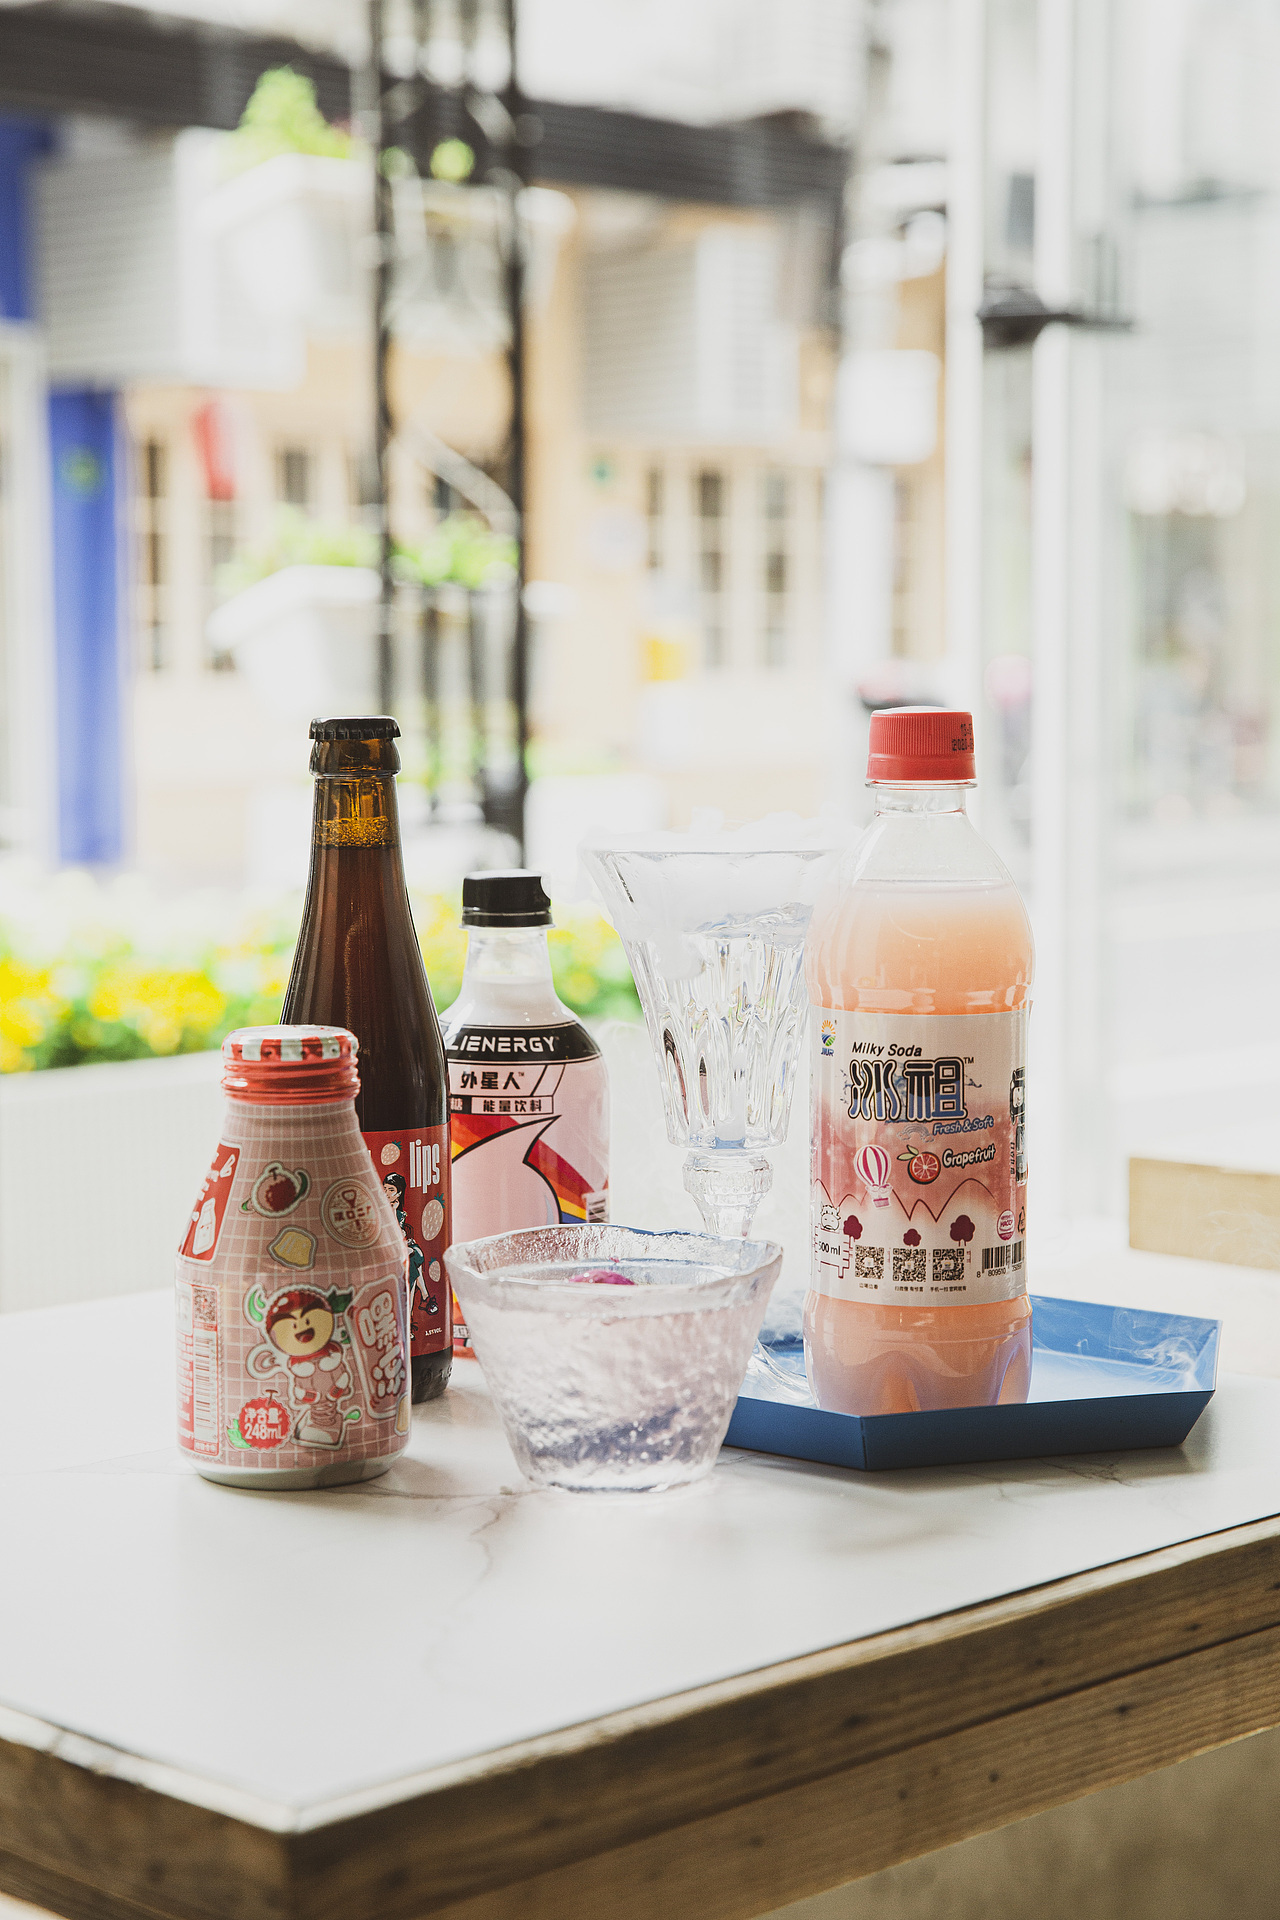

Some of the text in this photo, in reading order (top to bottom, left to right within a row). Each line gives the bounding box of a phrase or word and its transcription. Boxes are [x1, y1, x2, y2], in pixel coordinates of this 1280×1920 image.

[851, 1041, 884, 1057] Milky
[887, 1043, 923, 1057] Soda
[460, 1071, 520, 1090] 外星人
[483, 1099, 542, 1113] 能量饮料
[932, 1119, 961, 1136] Fresh
[942, 1143, 996, 1169] Grapefruit
[409, 1139, 440, 1194] lips
